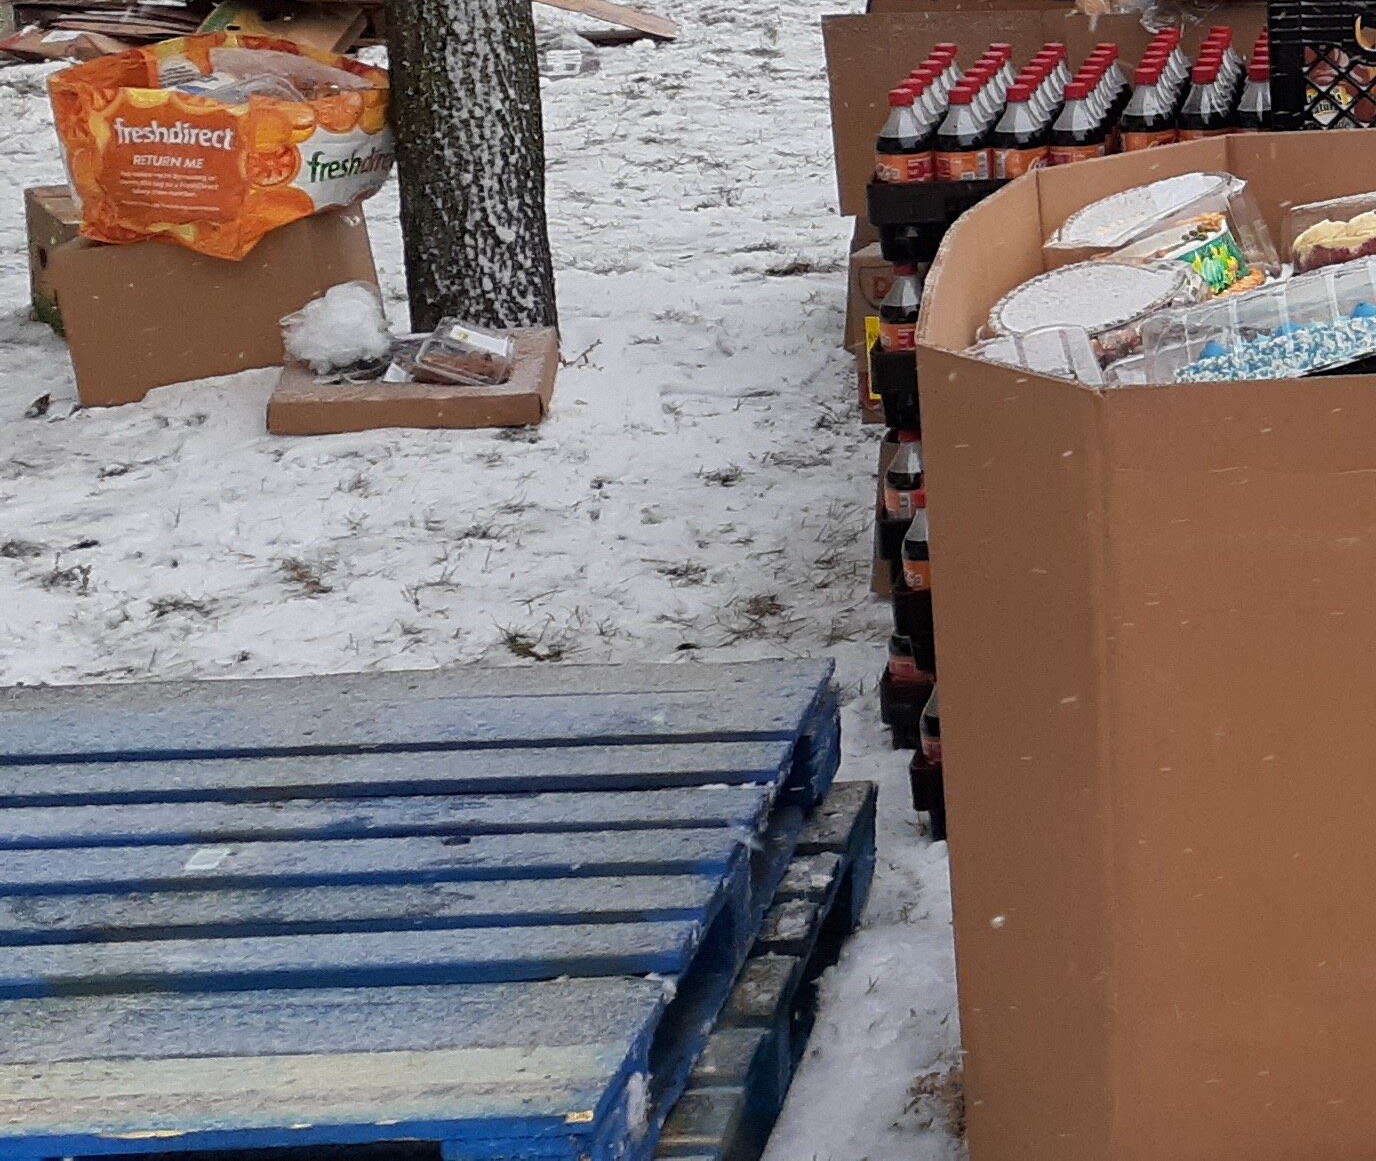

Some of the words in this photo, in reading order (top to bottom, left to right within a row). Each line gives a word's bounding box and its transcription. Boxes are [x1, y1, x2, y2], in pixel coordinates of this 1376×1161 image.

[114, 118, 234, 150] freshdirect
[132, 154, 182, 167] RETURN
[184, 158, 205, 169] ME
